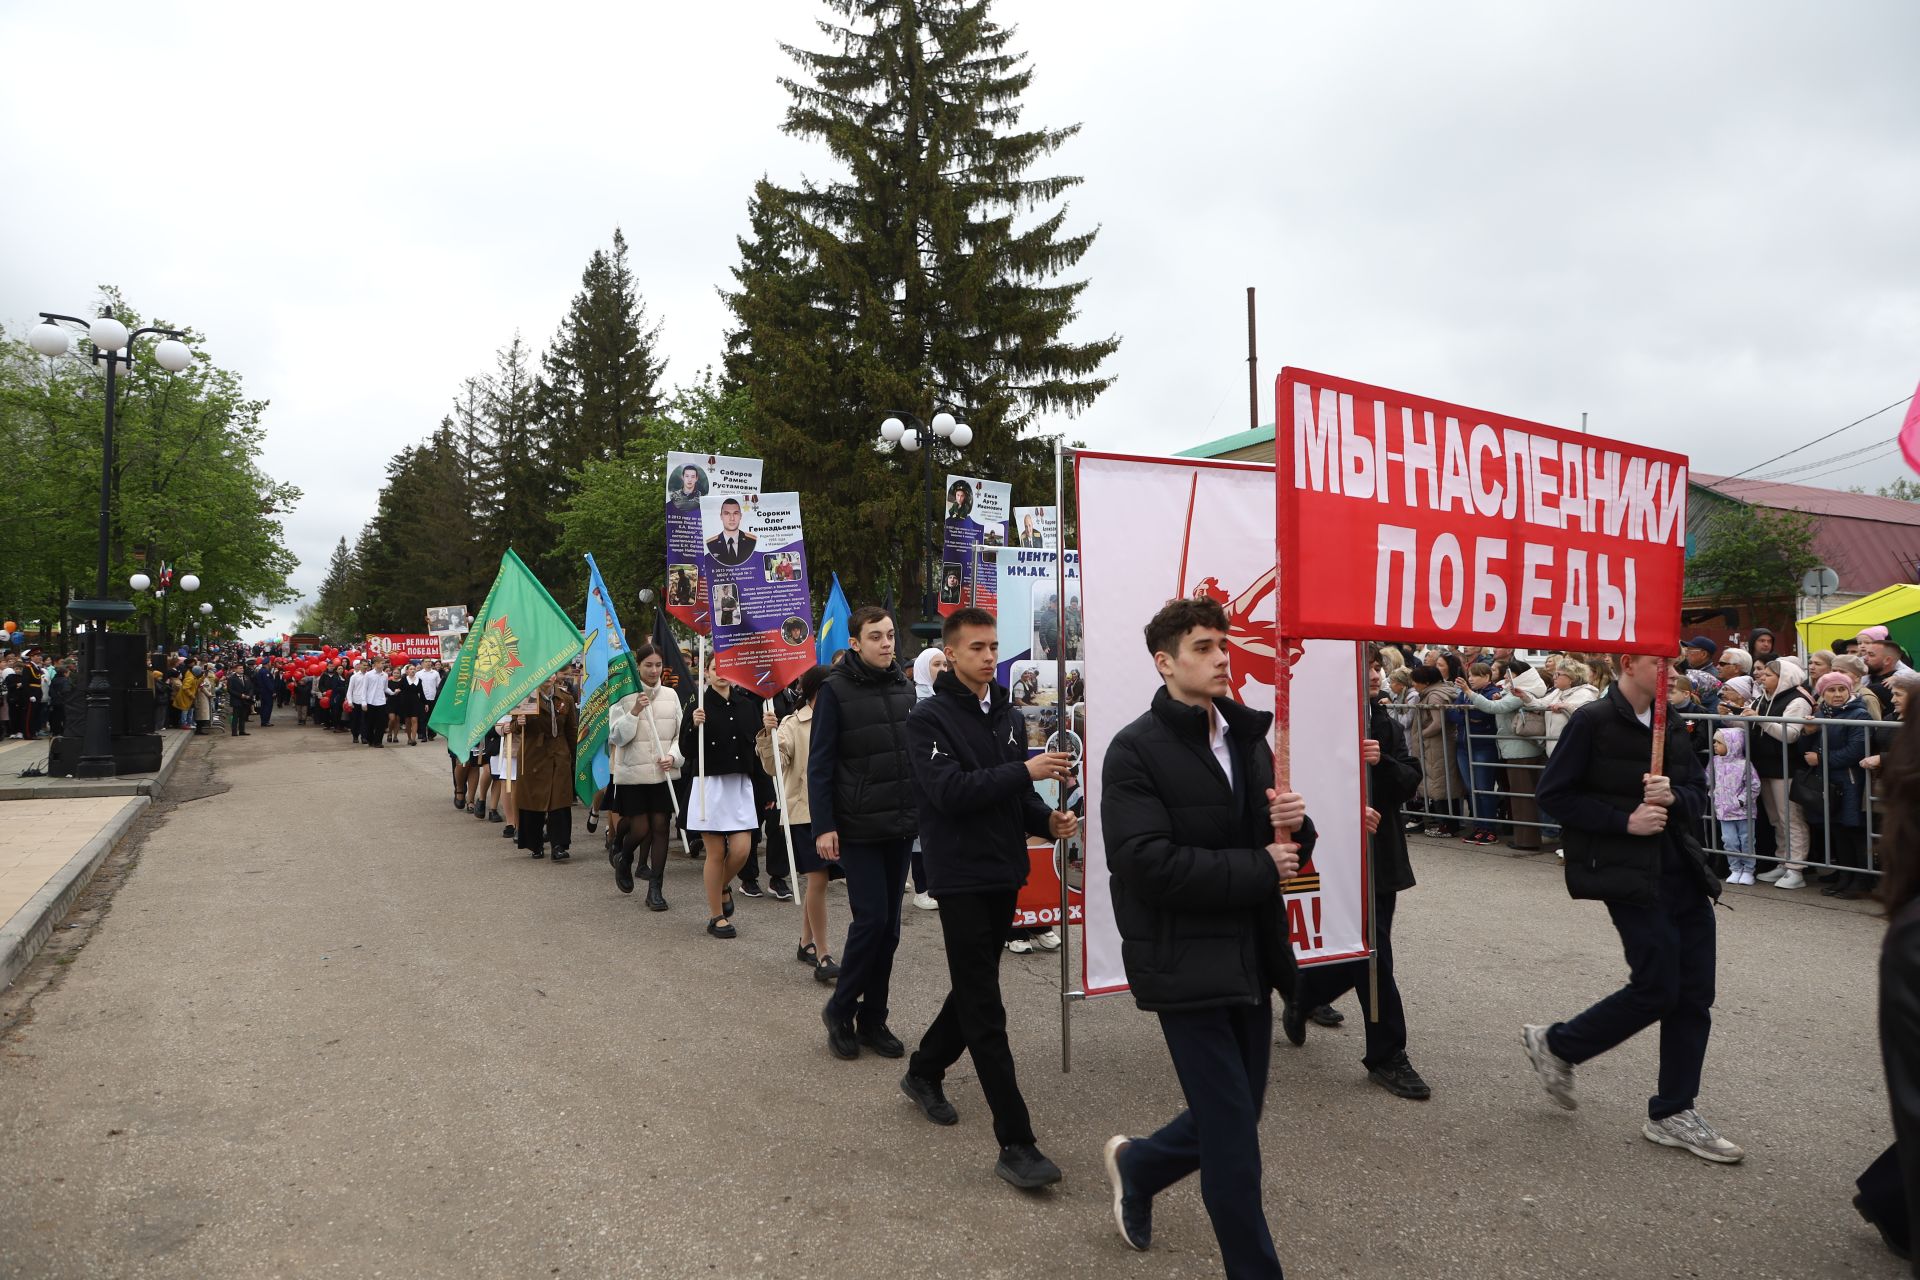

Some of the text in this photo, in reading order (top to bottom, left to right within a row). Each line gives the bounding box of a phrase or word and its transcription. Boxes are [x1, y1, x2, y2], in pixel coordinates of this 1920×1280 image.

[1293, 381, 1688, 548] МЫ-НАСЛЕДНИКИ
[720, 469, 752, 477] Сабиров
[712, 481, 758, 490] Рустамович
[748, 524, 801, 532] Геннадьевич
[1017, 551, 1057, 563] ЦЕНТР
[1374, 523, 1636, 642] ПОБЕДЫ
[370, 637, 438, 653] 80 ЛЕТ ВЕЛИКОЙ
[407, 647, 439, 655] ПОБЕДЫ
[454, 655, 472, 706] ВОЙСКА
[1287, 896, 1323, 951] А!
